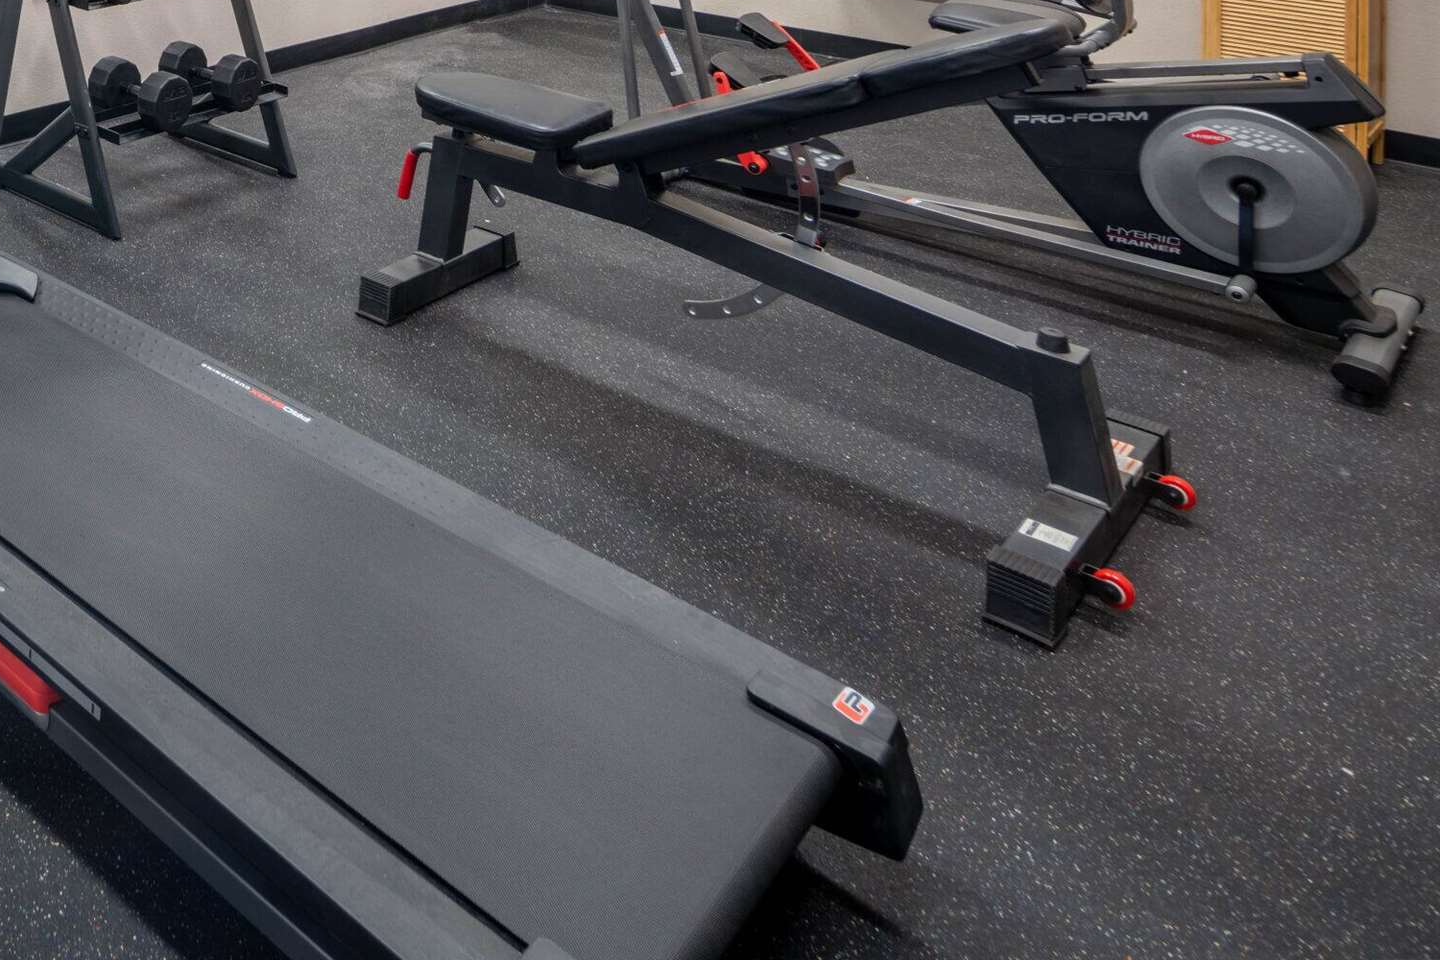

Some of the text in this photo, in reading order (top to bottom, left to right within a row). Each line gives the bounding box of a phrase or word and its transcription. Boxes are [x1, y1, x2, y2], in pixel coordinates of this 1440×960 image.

[1013, 111, 1149, 125] PRO-FORM
[1106, 224, 1182, 246] HYBRID
[1106, 234, 1182, 255] TRAINER
